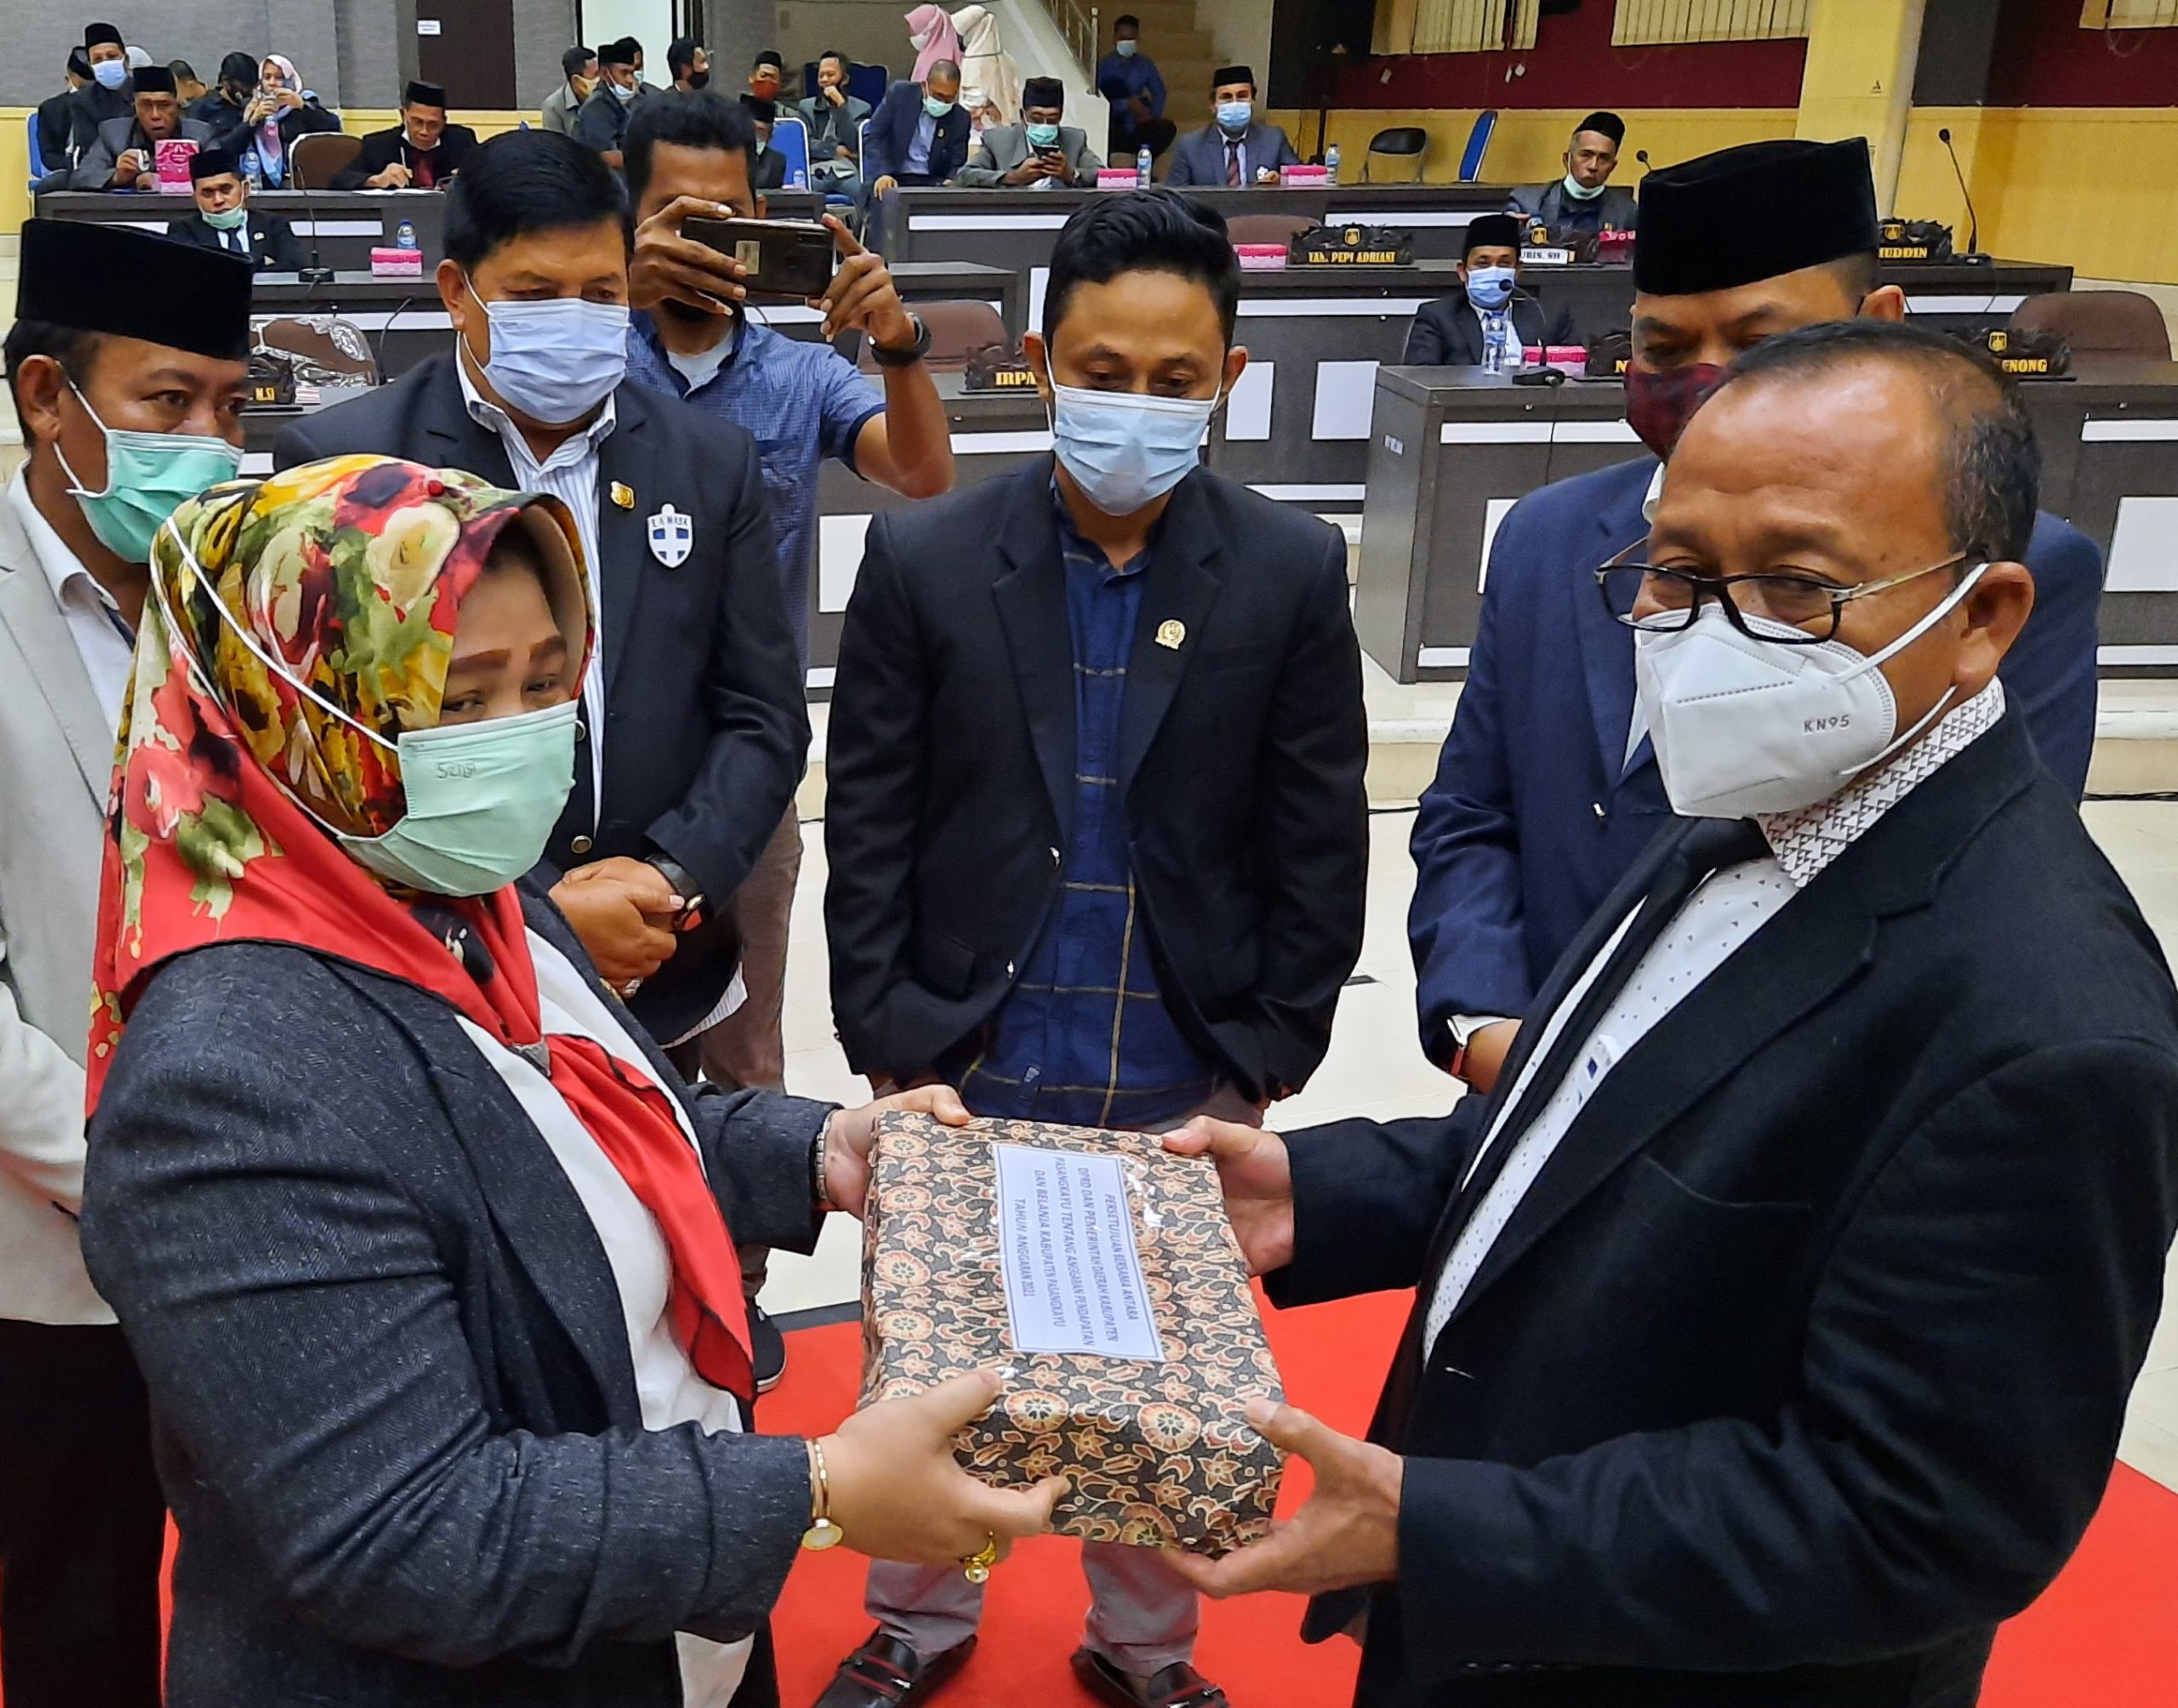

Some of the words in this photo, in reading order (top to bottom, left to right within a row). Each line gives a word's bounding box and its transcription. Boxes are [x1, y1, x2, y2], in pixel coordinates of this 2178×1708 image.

[1355, 252, 1396, 263] ADRIANI
[995, 371, 1037, 385] IRPA
[1804, 715, 1850, 732] KN95
[1034, 1170, 1047, 1187] DAN
[1054, 1157, 1073, 1210] PASANGKAYU
[1014, 1198, 1029, 1233] TAHUN
[1035, 1188, 1051, 1227] BELANJA
[1081, 1189, 1095, 1210] DAN
[1061, 1210, 1077, 1255] TENTANG
[1084, 1210, 1103, 1266] PEMERINTAH
[1103, 1193, 1124, 1253] PERSETUJUAN
[1016, 1233, 1033, 1280] ANGGARAN
[1039, 1230, 1058, 1278] KABUPATEN
[1113, 1253, 1132, 1288] BERSAMA
[1021, 1280, 1035, 1297] 2021
[1066, 1255, 1086, 1295] ANGGARAN
[1092, 1266, 1110, 1295] DAERAH
[1046, 1278, 1067, 1327] PASANGKAYU
[1074, 1295, 1096, 1346] PENDAPATAN
[1098, 1295, 1119, 1342] KABUPATEN
[1121, 1288, 1140, 1321] ANTARA
